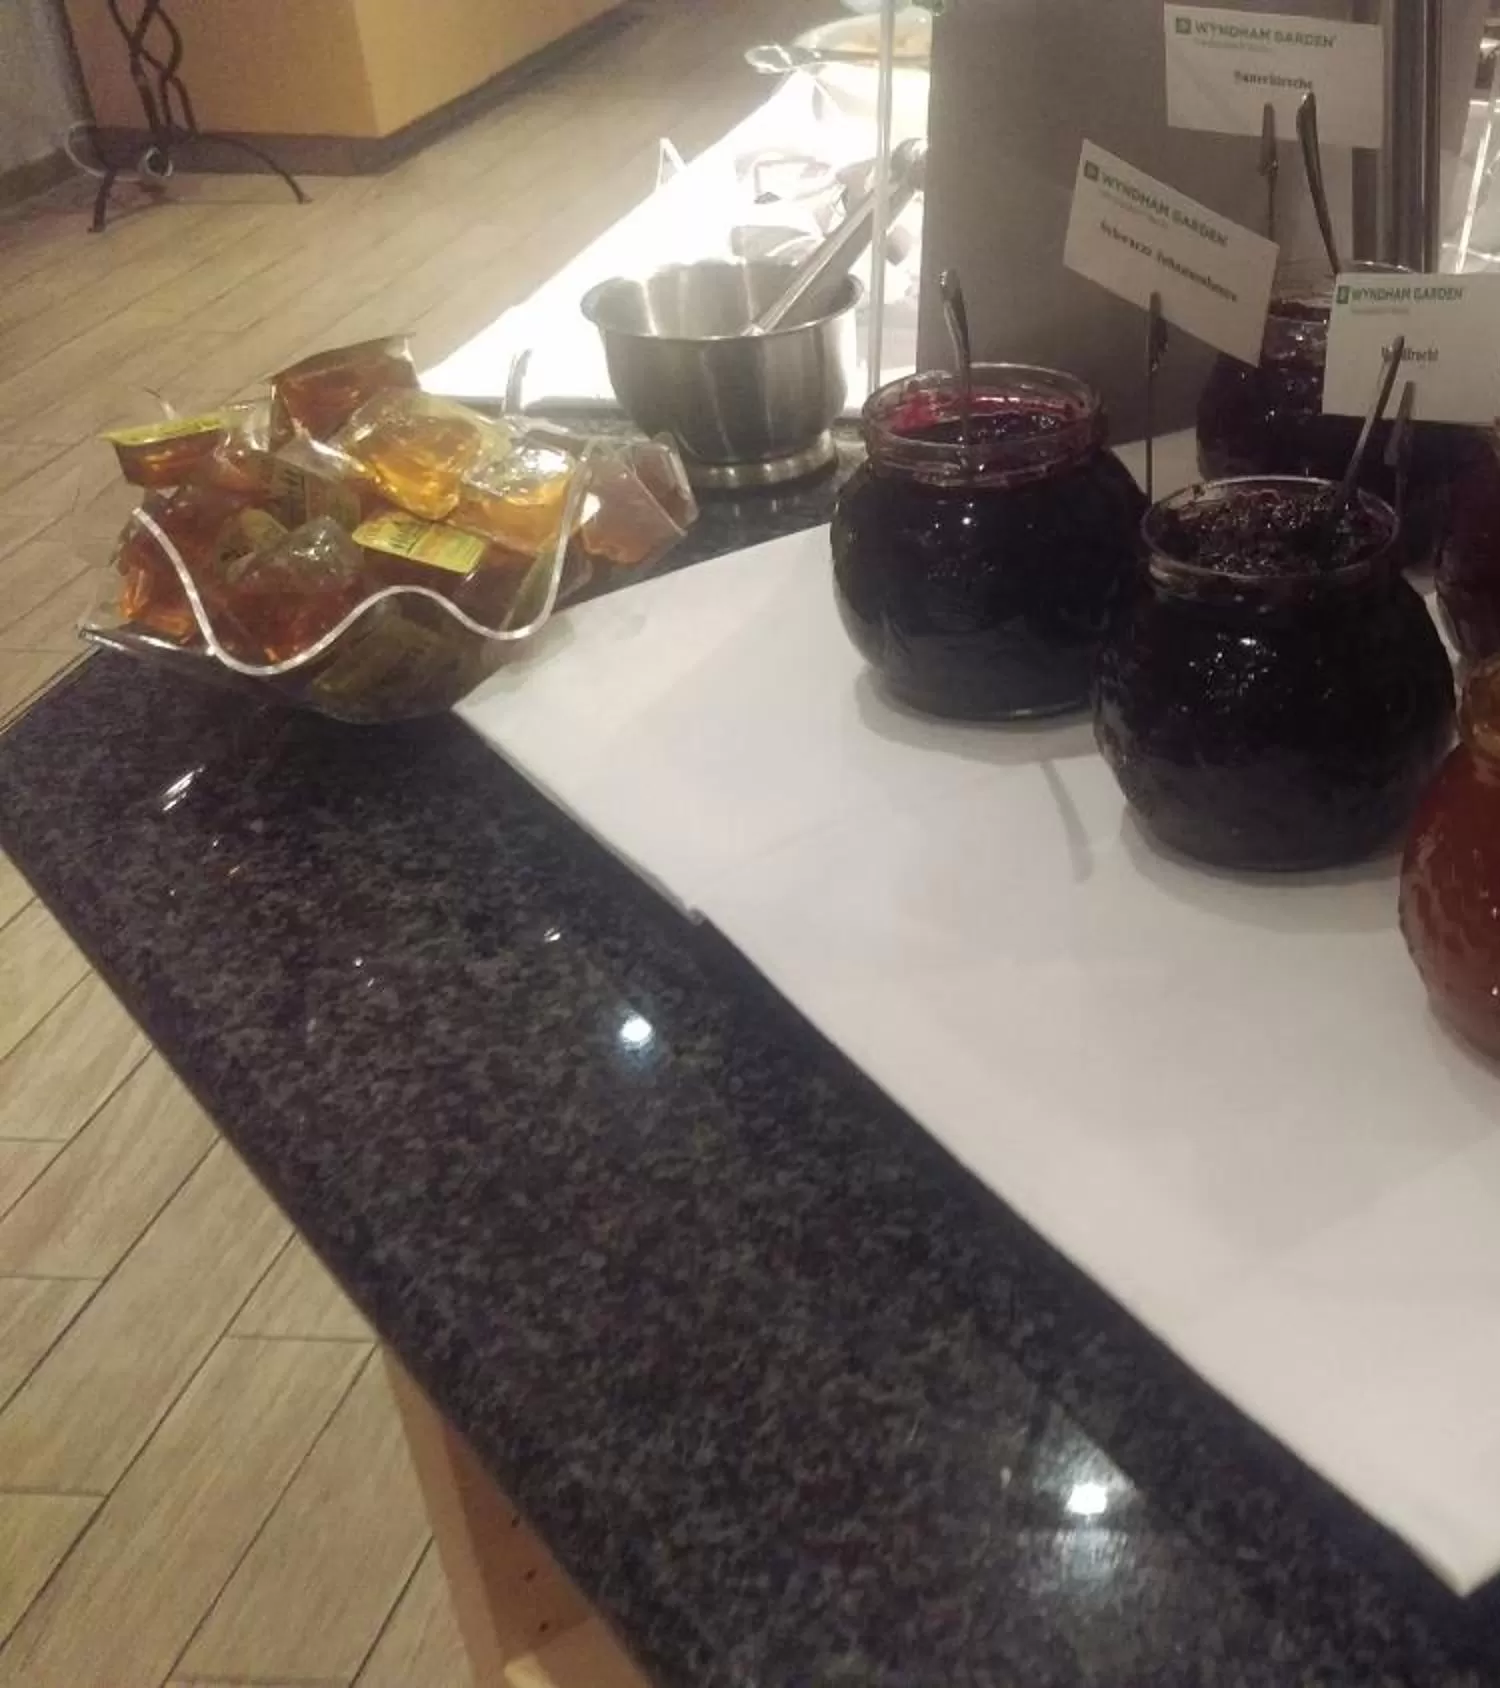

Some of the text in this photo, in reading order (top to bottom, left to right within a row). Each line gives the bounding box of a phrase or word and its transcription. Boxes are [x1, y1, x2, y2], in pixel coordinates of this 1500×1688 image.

[1194, 18, 1271, 42] WYNDHAM
[1273, 33, 1335, 49] GARDEN
[1100, 171, 1170, 217] WYNDHAM
[1171, 209, 1229, 248] GARDEN
[1351, 286, 1464, 301] WYNDHAM GARDEN
